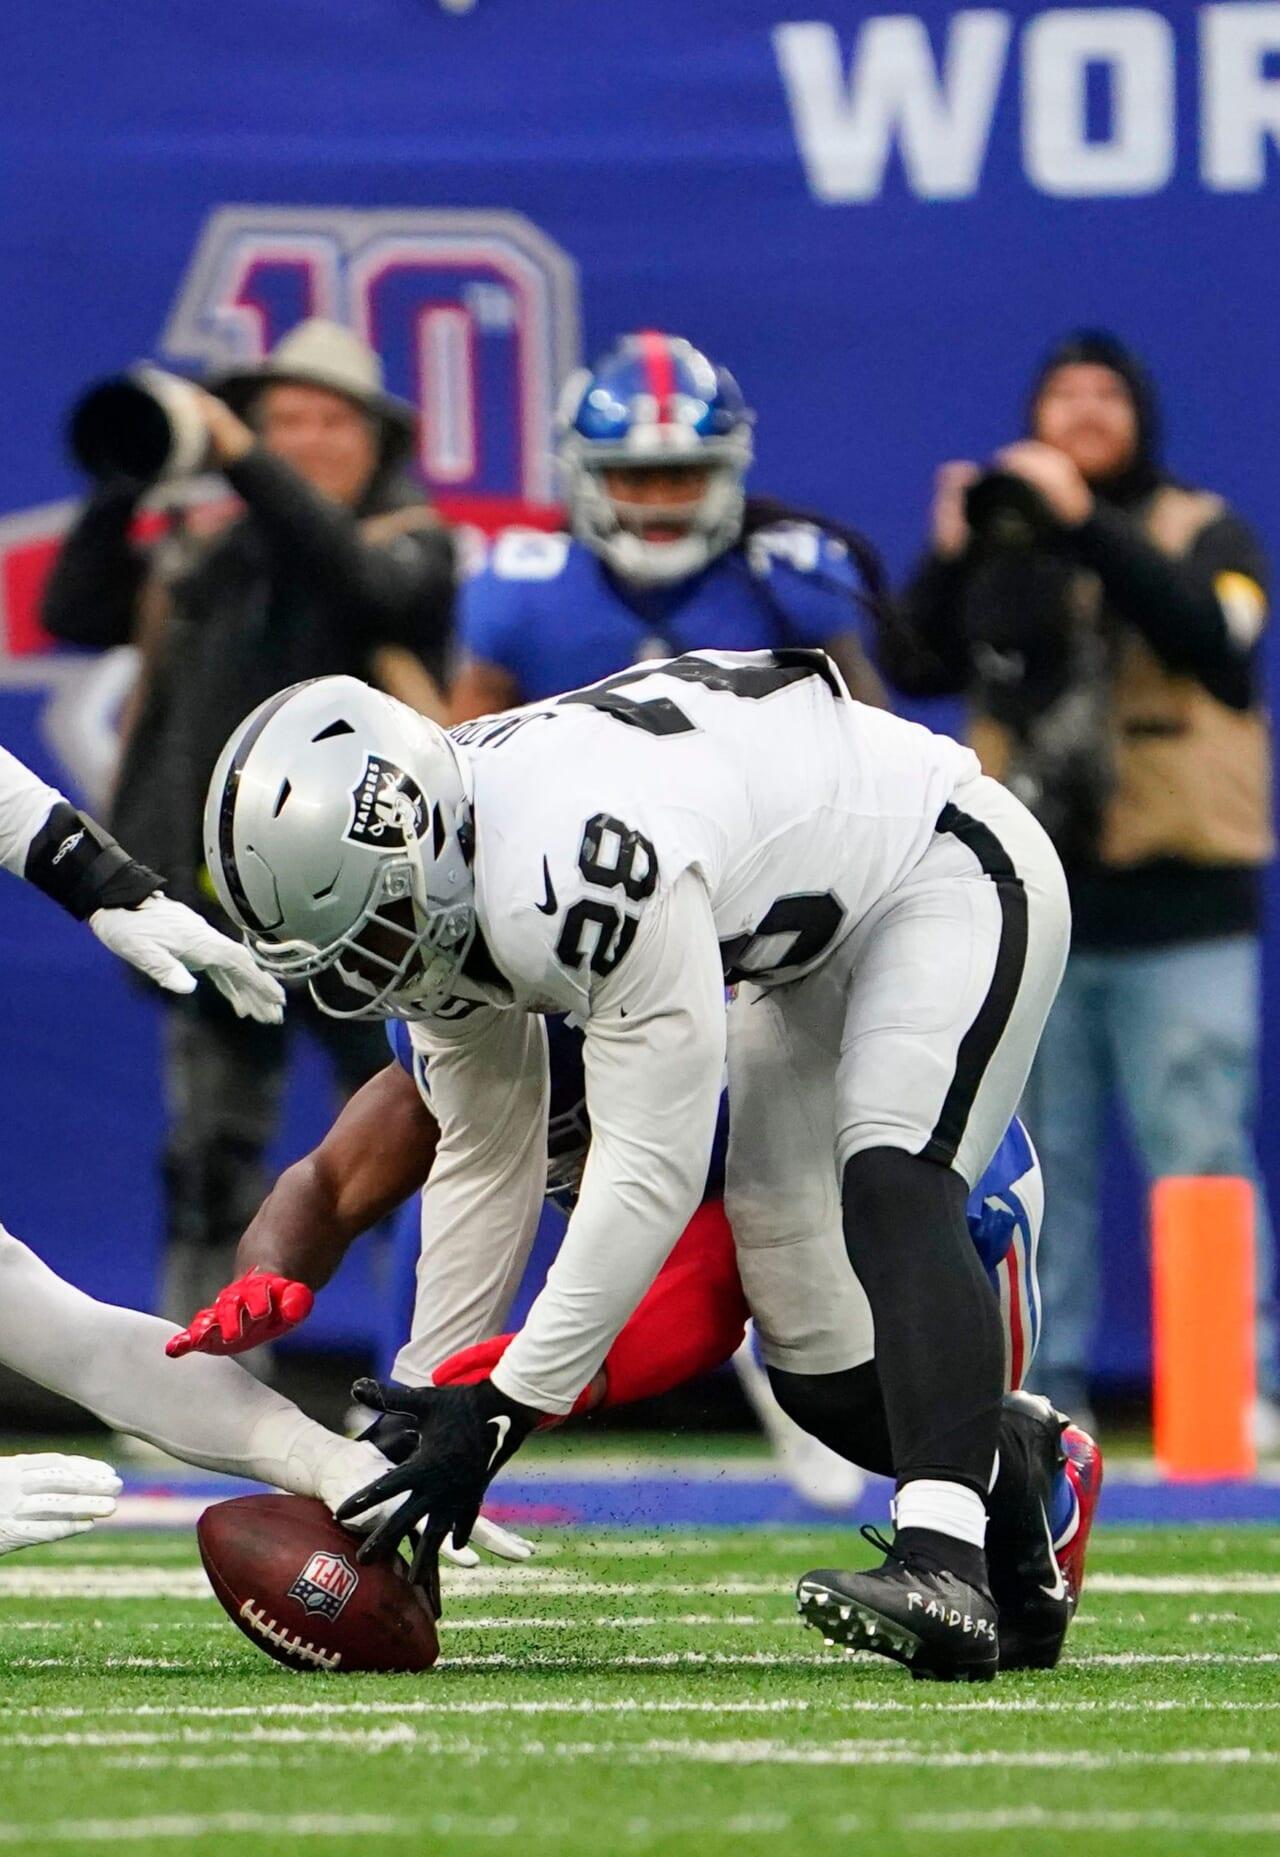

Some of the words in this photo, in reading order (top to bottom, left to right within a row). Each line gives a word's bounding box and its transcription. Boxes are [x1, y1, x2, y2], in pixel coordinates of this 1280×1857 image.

[353, 762, 380, 834] RAIDERS
[556, 812, 659, 978] 28
[310, 1558, 353, 1598] NFL
[907, 1591, 996, 1641] RAIDERS
